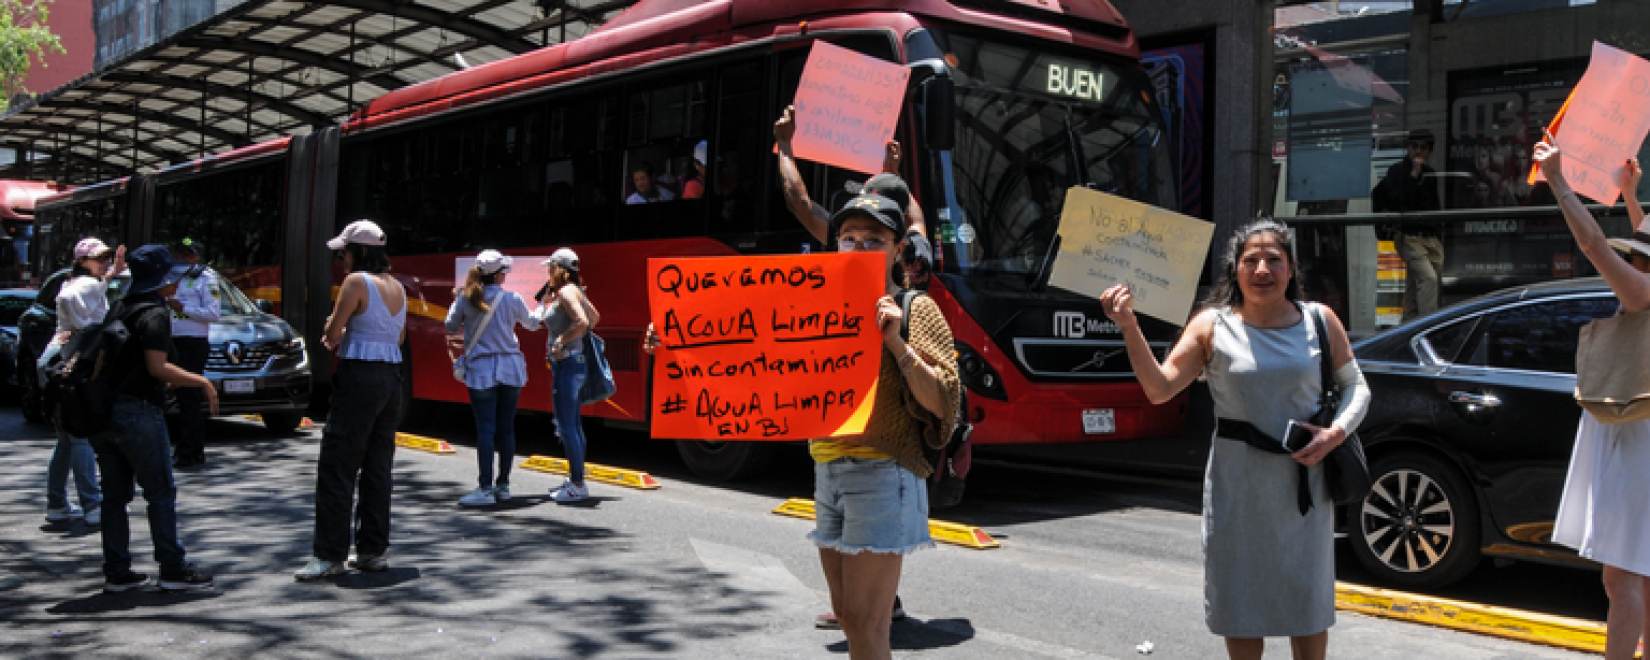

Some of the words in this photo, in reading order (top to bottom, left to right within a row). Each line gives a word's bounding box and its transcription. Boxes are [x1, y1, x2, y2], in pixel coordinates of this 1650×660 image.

[1047, 64, 1103, 101] BUEN
[1089, 205, 1111, 228] No
[1053, 311, 1086, 338] MB
[1087, 318, 1122, 334] Metro
[718, 419, 750, 437] EN
